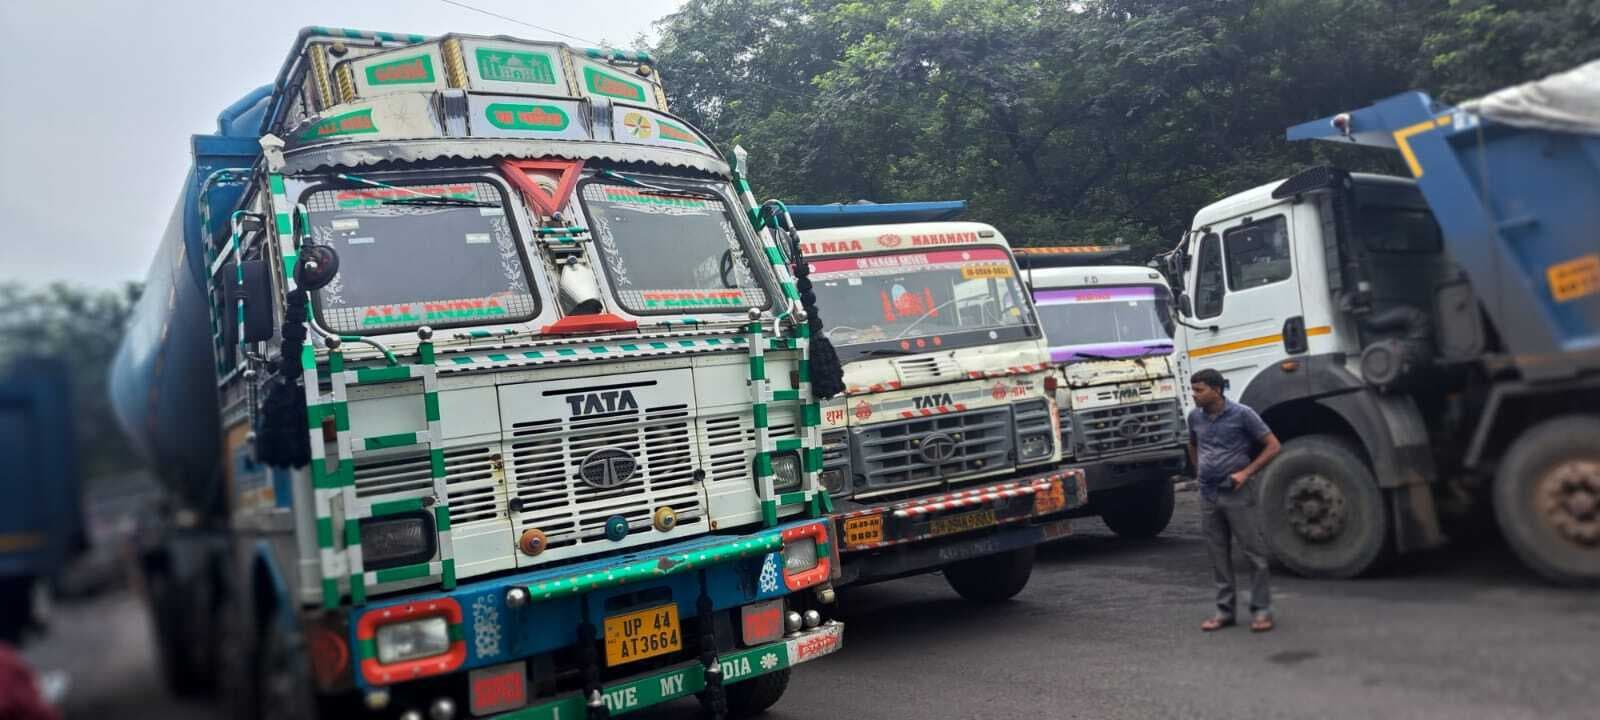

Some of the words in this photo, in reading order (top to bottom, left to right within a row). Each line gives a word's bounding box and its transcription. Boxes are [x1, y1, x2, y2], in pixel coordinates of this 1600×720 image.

[822, 239, 863, 253] MAA
[911, 231, 978, 246] MAHAMAYA
[362, 304, 421, 326] ALL
[424, 297, 506, 320] INDIA
[643, 291, 744, 308] PERMIT
[566, 390, 638, 416] TATA
[912, 392, 953, 409] TATA
[826, 409, 844, 425] शुभ
[624, 618, 642, 638] UP
[654, 611, 671, 629] 44
[621, 629, 678, 658] AT3664
[601, 686, 638, 711] OVE
[660, 674, 684, 696] MY
[722, 656, 752, 680] DIA
